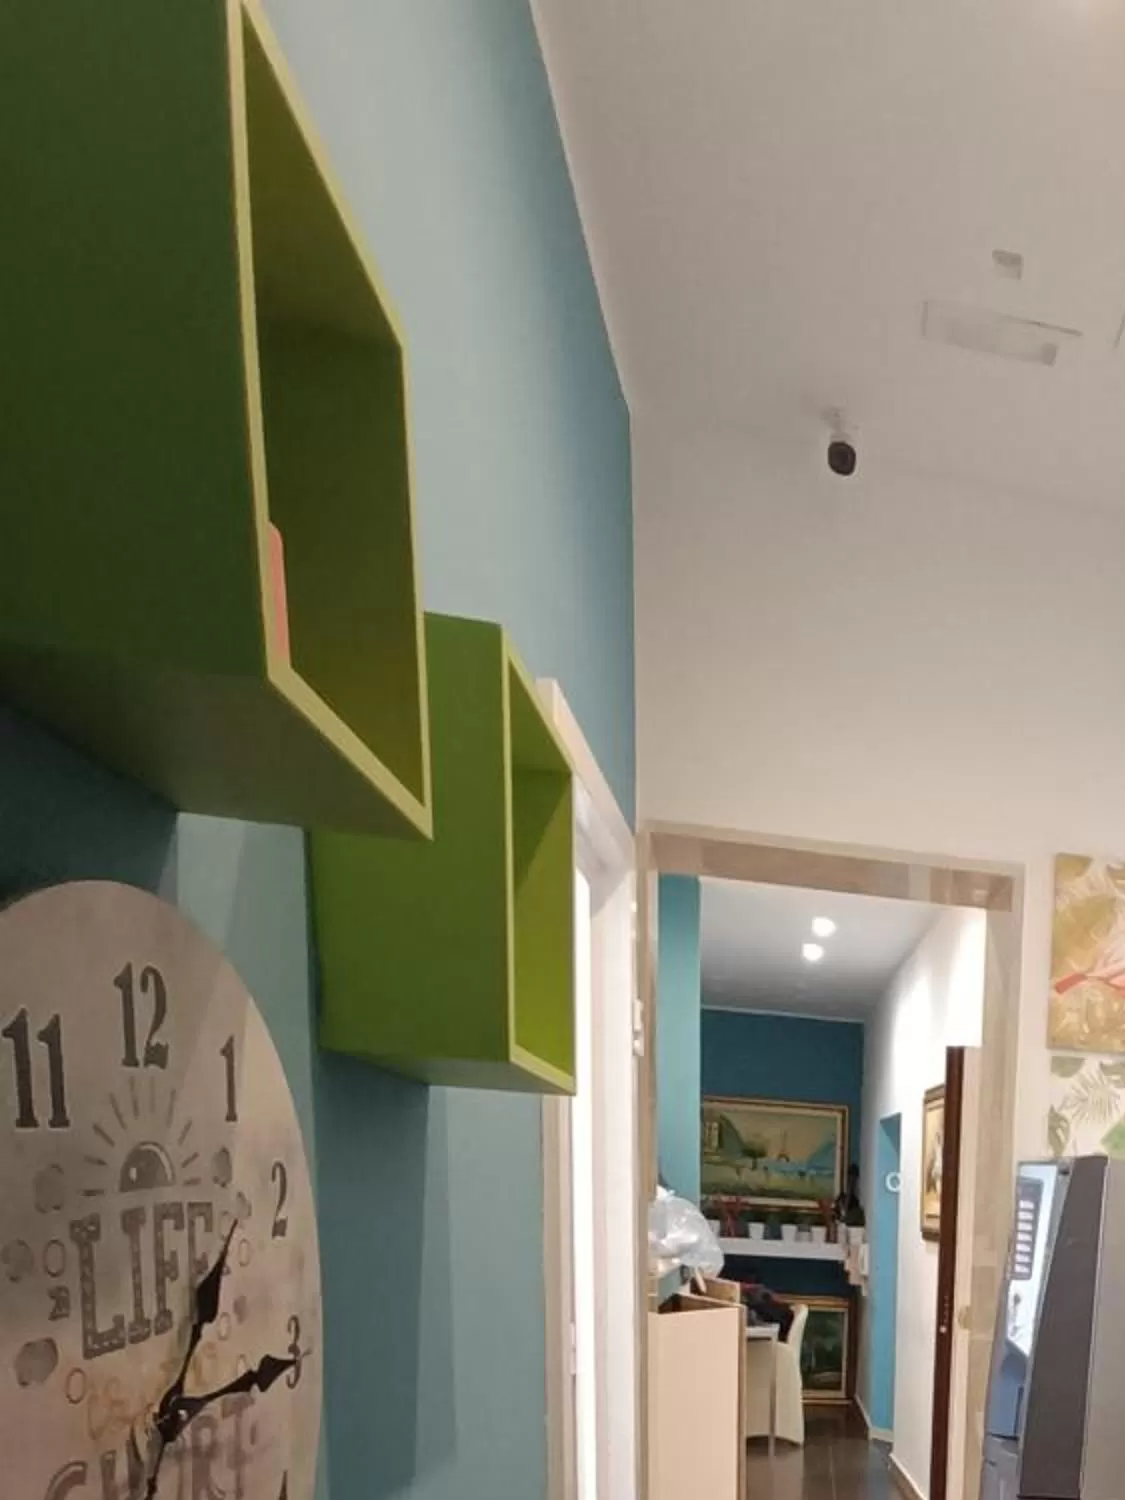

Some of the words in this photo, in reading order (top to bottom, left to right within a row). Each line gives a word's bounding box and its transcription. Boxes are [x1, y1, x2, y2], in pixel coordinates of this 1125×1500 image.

[114, 961, 170, 1070] 12
[2, 1007, 70, 1129] 11
[219, 1035, 239, 1123] 1
[270, 1160, 289, 1239] 2
[286, 1315, 302, 1390] 3
